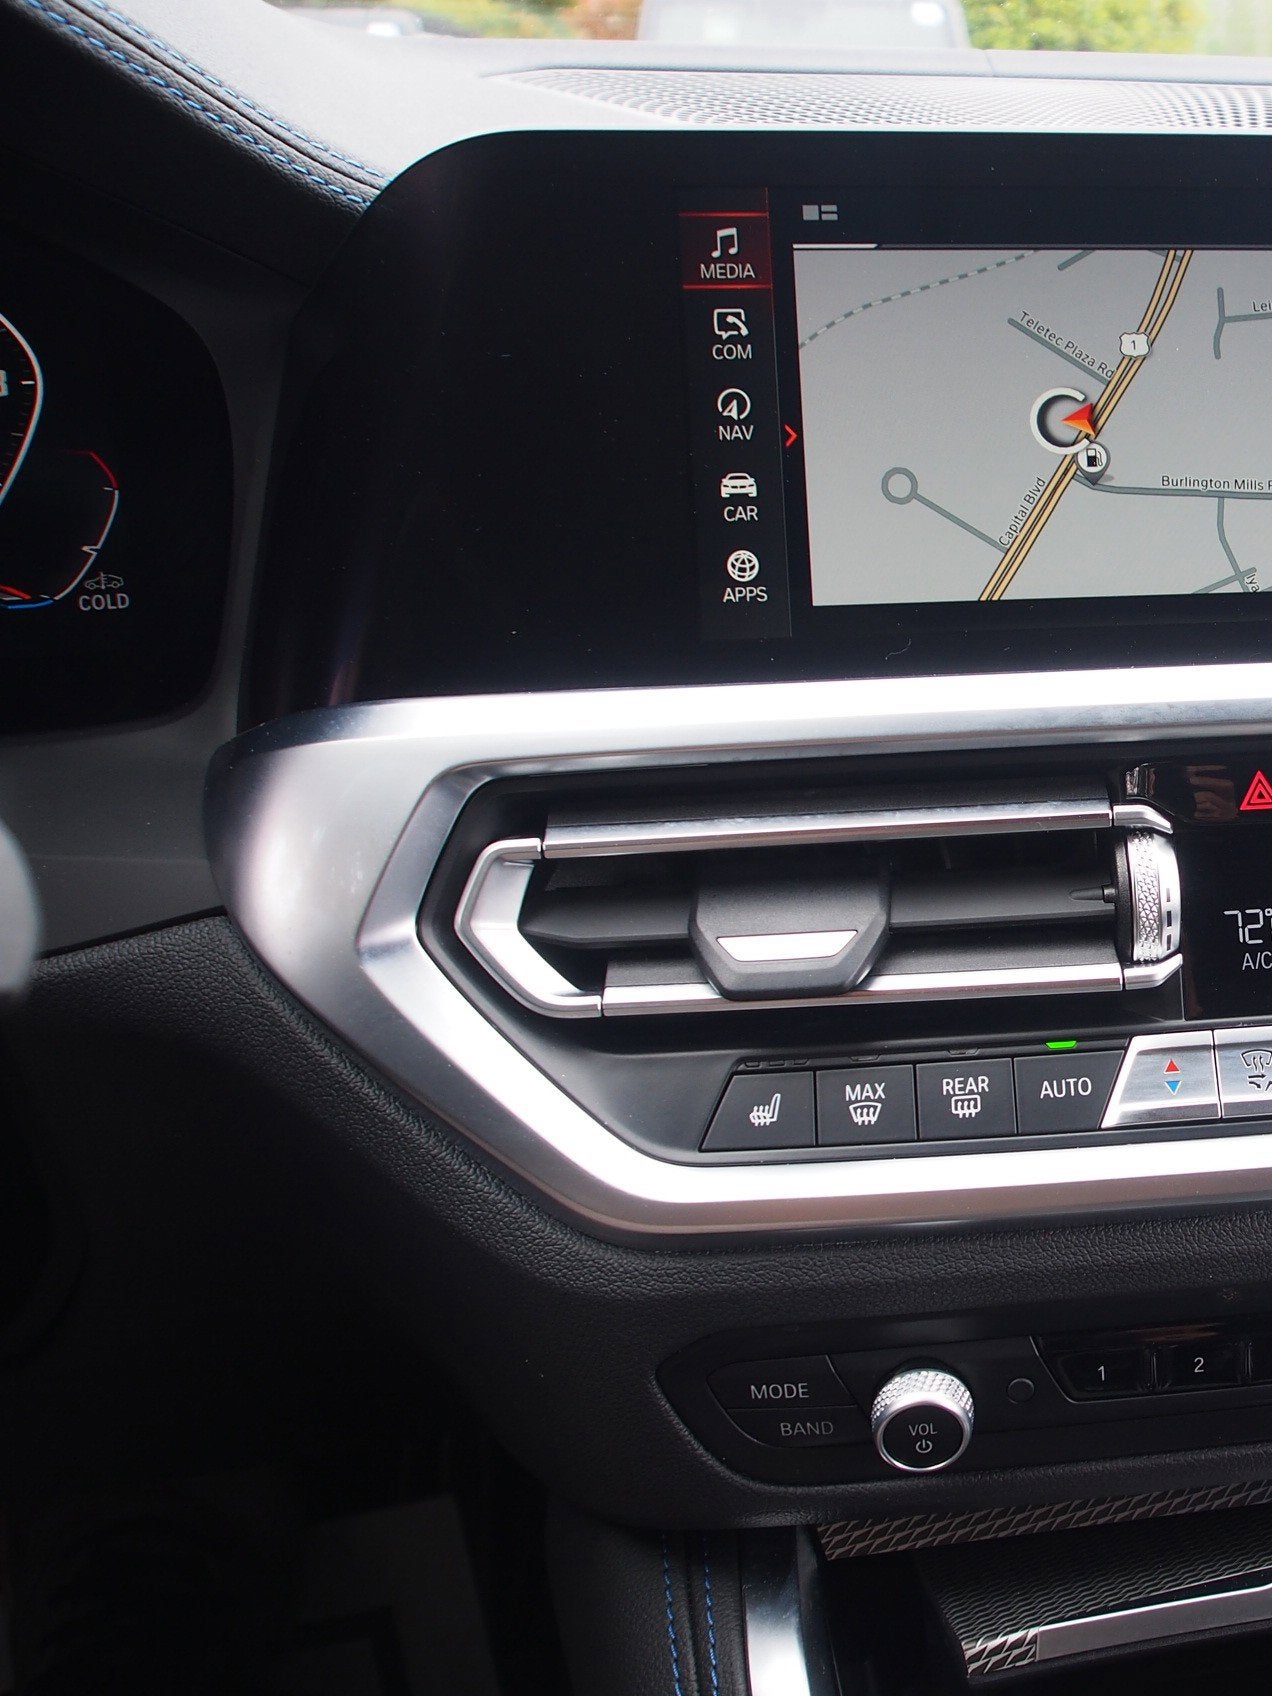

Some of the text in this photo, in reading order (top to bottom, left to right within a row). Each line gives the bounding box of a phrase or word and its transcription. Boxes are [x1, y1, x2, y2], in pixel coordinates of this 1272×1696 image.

[699, 263, 755, 280] MEDIA
[711, 344, 752, 360] COM
[1019, 310, 1115, 379] Teletec Plaza Rd
[1131, 340, 1137, 350] 1
[717, 425, 754, 441] NAV
[1160, 475, 1230, 491] Burlington
[1233, 478, 1264, 491] Mills
[723, 505, 759, 522] CAR
[998, 476, 1046, 547] Capital Blvd
[78, 593, 130, 611] COLD
[722, 586, 768, 603] APPS
[845, 1082, 886, 1102] MAX
[942, 1075, 990, 1095] REAR
[1039, 1076, 1092, 1099] AUTO
[1097, 1365, 1107, 1382] 1
[1193, 1357, 1205, 1374] 2
[750, 1382, 810, 1400] MODE
[780, 1420, 834, 1437] BAND
[908, 1422, 938, 1436] VOL
